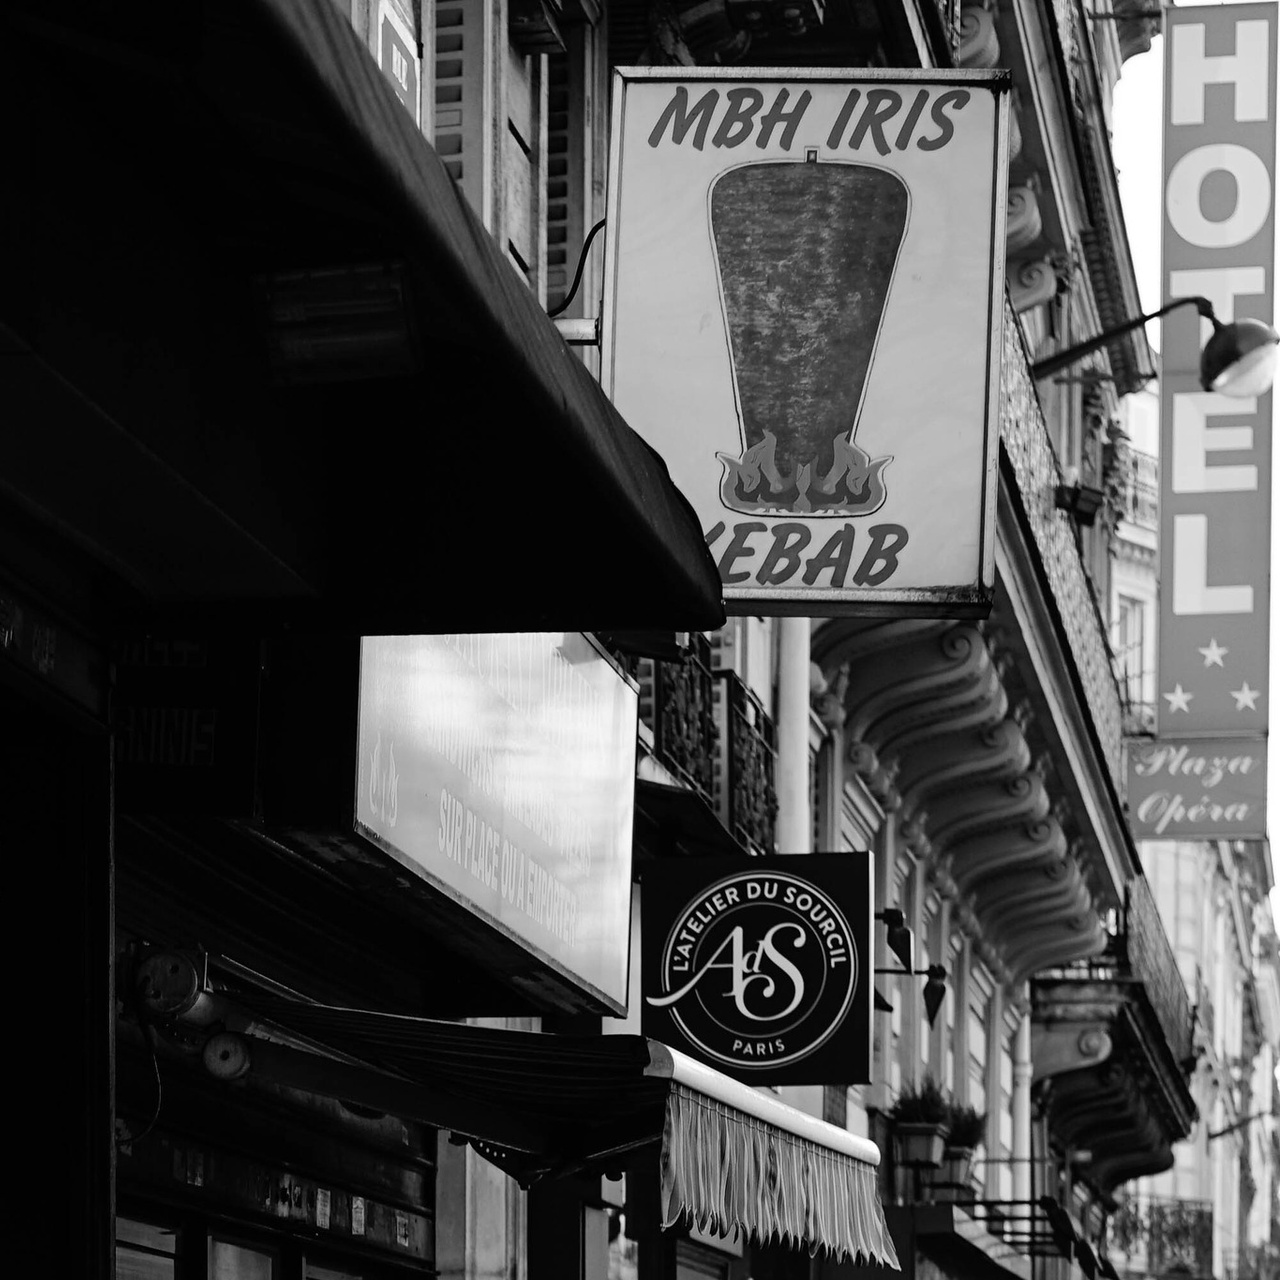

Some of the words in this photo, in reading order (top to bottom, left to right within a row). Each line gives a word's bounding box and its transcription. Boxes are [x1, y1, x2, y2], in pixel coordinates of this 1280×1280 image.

[647, 86, 812, 152] MBH
[825, 87, 971, 156] IRIS
[1166, 19, 1272, 617] HOTEL
[1134, 744, 1260, 792] Plaza
[1137, 790, 1252, 836] Opéra
[438, 787, 464, 866] SUR
[464, 808, 500, 892] PLACE
[501, 838, 517, 905] OU
[526, 857, 577, 948] EMPORTER
[672, 885, 742, 972] L'ATELIER
[745, 880, 776, 903] DU
[782, 886, 849, 971] SOURCIL
[732, 1038, 786, 1056] PARIS
